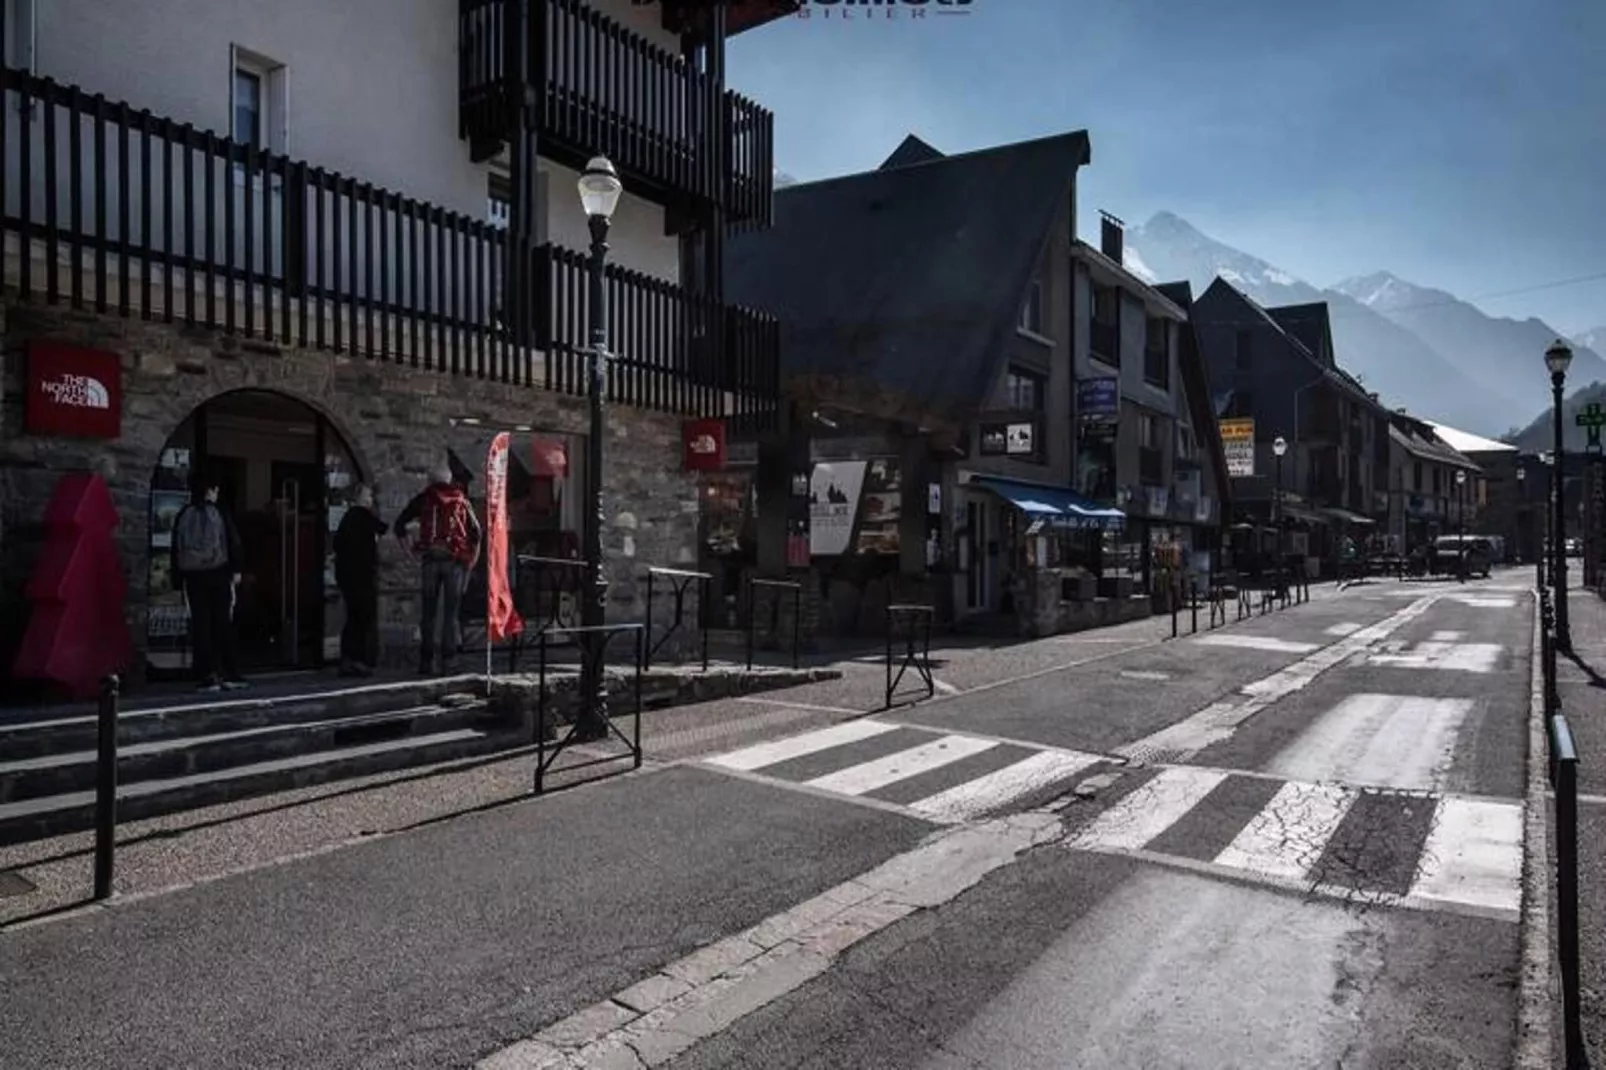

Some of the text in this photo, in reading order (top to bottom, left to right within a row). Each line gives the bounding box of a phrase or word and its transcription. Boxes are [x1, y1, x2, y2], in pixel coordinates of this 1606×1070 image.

[41, 380, 87, 394] NORTH
[63, 374, 84, 386] THE
[54, 392, 87, 406] FACE
